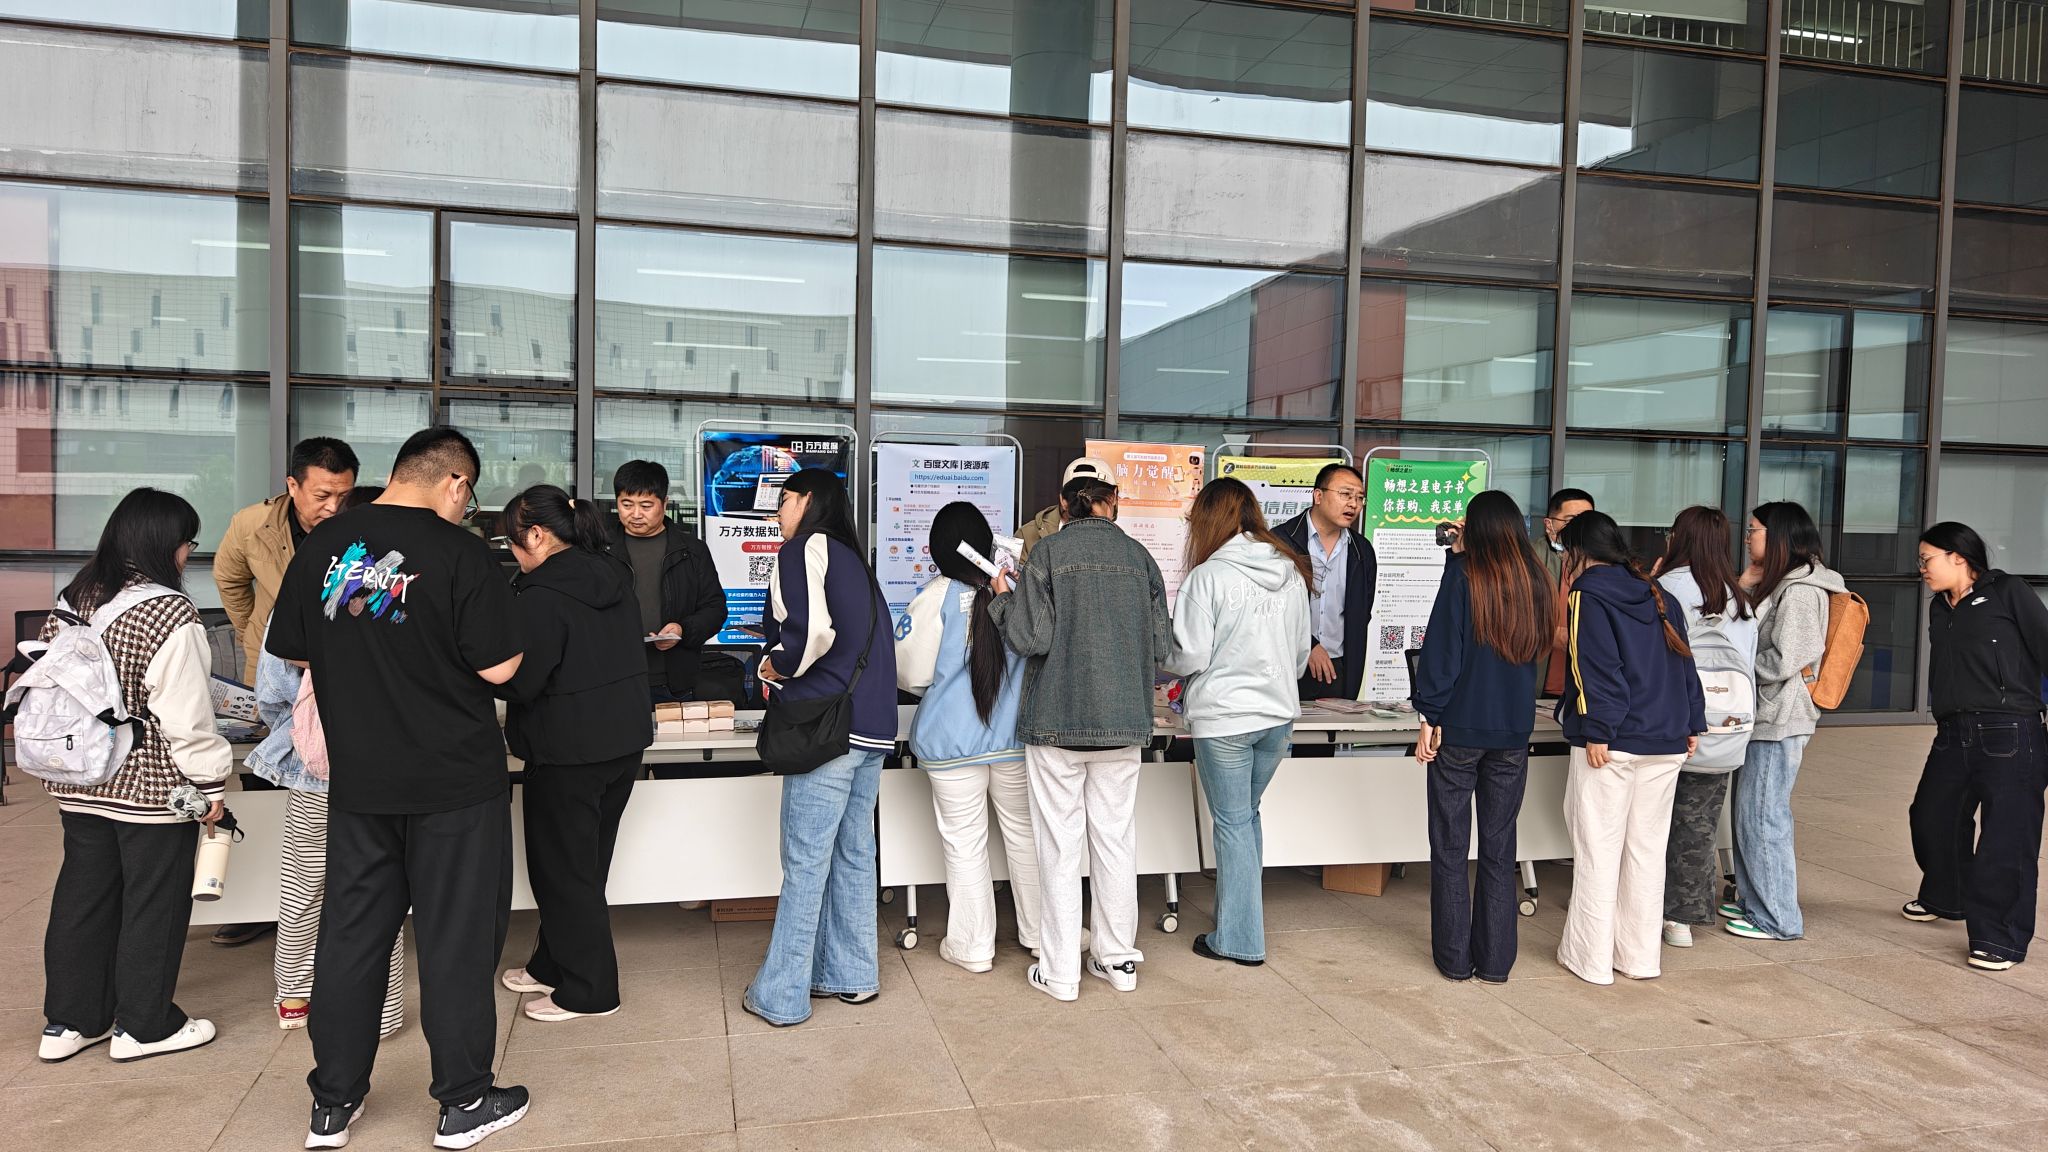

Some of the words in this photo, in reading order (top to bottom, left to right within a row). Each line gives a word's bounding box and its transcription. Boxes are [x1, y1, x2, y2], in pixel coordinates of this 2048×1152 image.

[805, 441, 839, 450] 万方数据
[914, 473, 984, 481] https://eduai.baidu.com
[1116, 463, 1175, 480] 脑力觉醒
[1384, 478, 1465, 494] 畅想之星电子书
[719, 525, 784, 538] 万方数据知
[323, 556, 415, 604] ETERNITY
